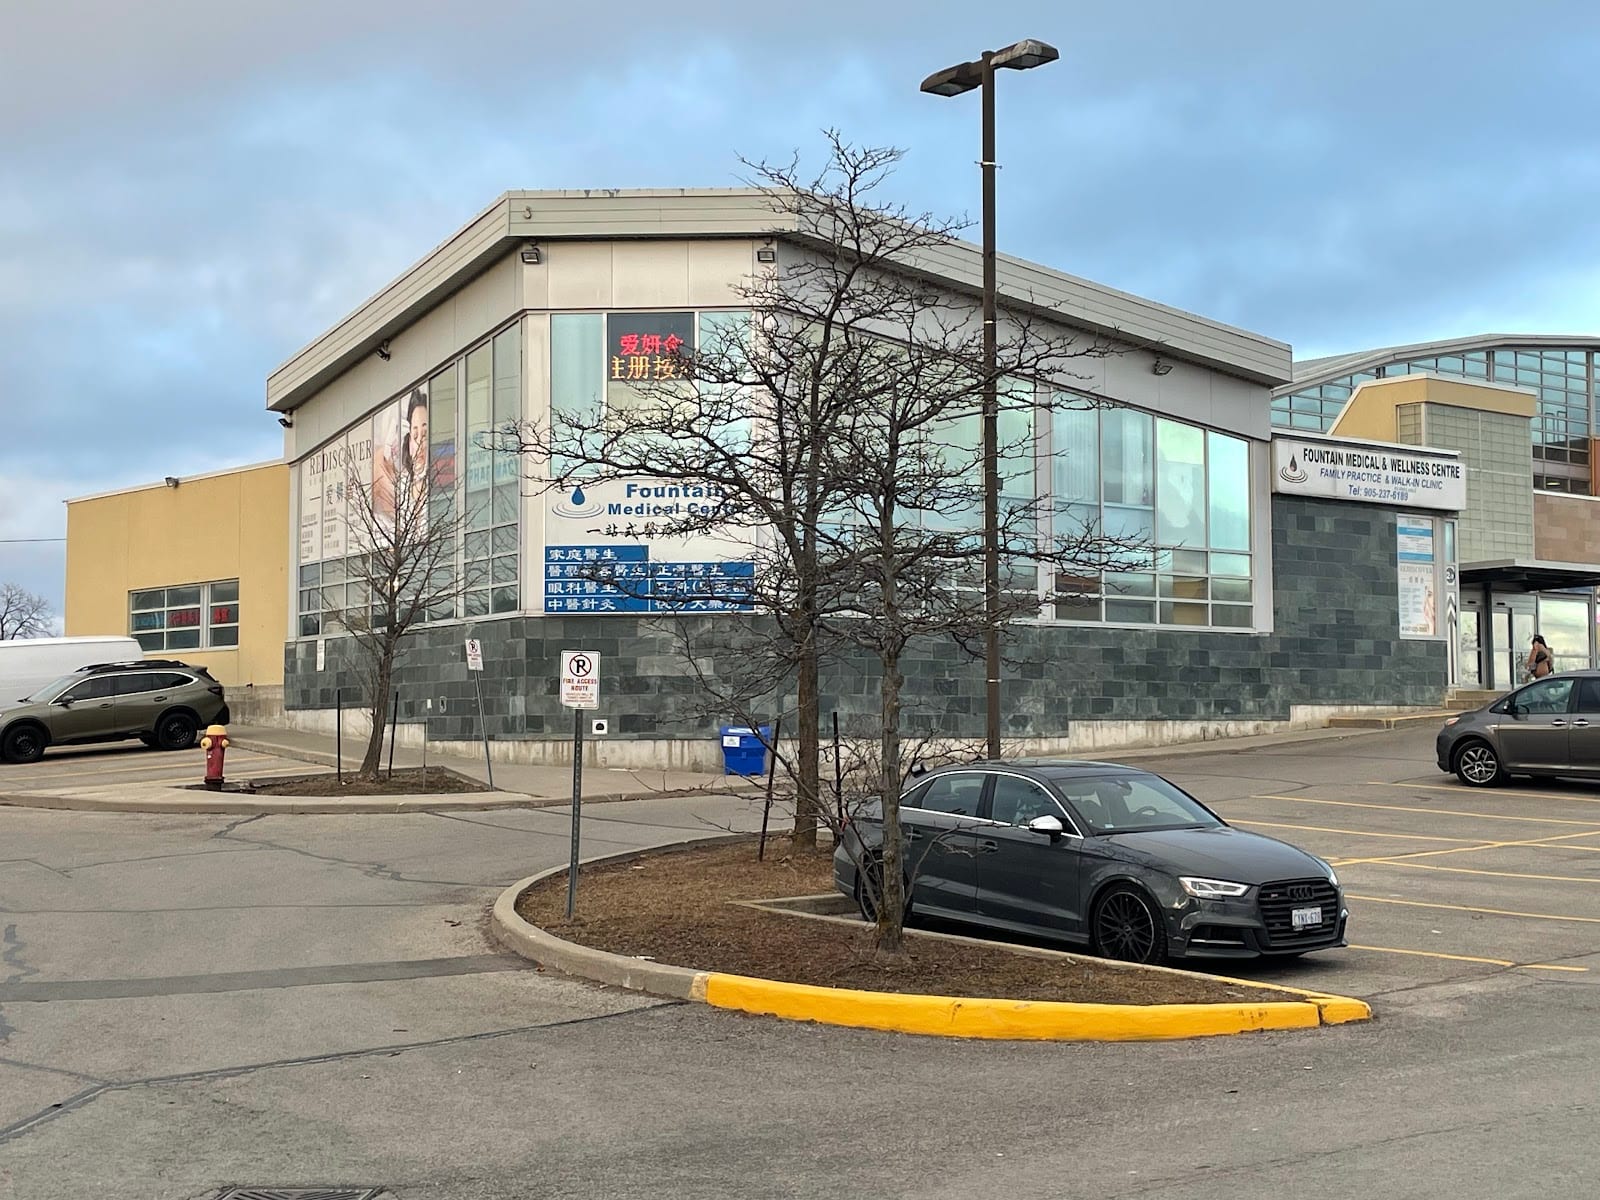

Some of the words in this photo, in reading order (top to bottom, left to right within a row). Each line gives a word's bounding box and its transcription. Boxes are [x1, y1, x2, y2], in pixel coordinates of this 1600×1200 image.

[309, 439, 372, 476] REDISCOVER
[1303, 447, 1344, 467] FOUNTAIN
[1345, 453, 1380, 470] MEDICAL
[1382, 457, 1387, 471] &
[1390, 458, 1430, 476] WELLNESS
[1431, 463, 1460, 479] CENTRE
[1320, 467, 1345, 480] FAMILY
[1346, 471, 1382, 483] PRACTICE
[1385, 474, 1390, 485] &
[1391, 476, 1420, 488] WALK-IN
[1421, 479, 1443, 490] CLINIC
[626, 483, 726, 498] Fountain
[1348, 484, 1363, 496] Tel:
[608, 502, 680, 515] Medical
[549, 548, 618, 561] 家庭醫生
[548, 581, 618, 594] 眼科醫生
[548, 598, 617, 611] 中醫針灸
